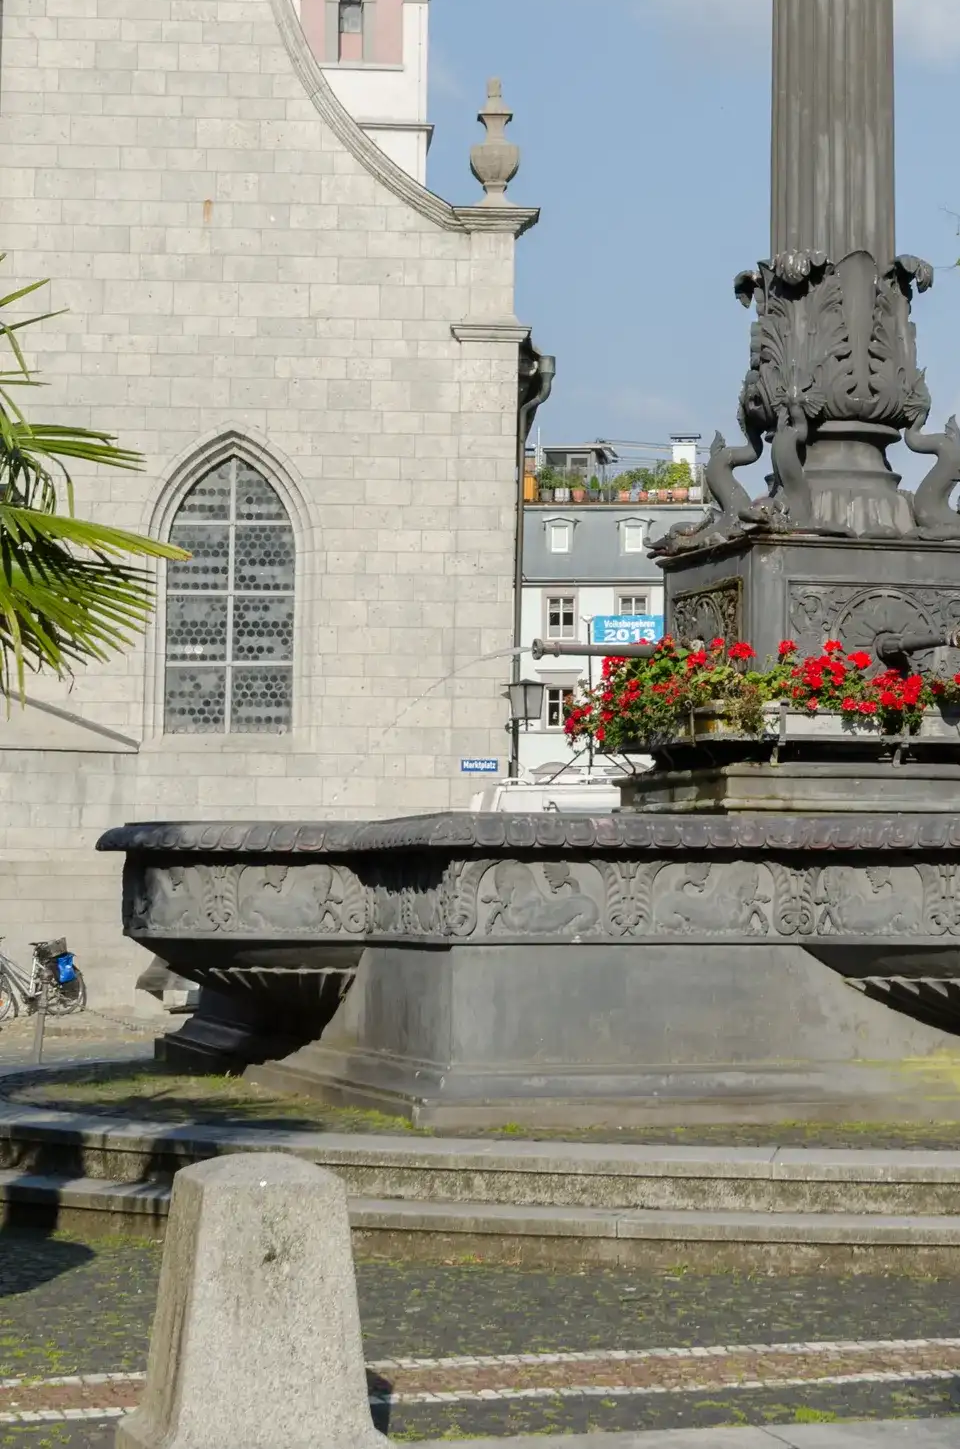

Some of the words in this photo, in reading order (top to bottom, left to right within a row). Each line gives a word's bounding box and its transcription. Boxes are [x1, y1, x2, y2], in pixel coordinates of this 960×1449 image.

[603, 619, 656, 630] Volksbegehren
[603, 628, 656, 642] 2013
[463, 760, 496, 770] Marktplatz
